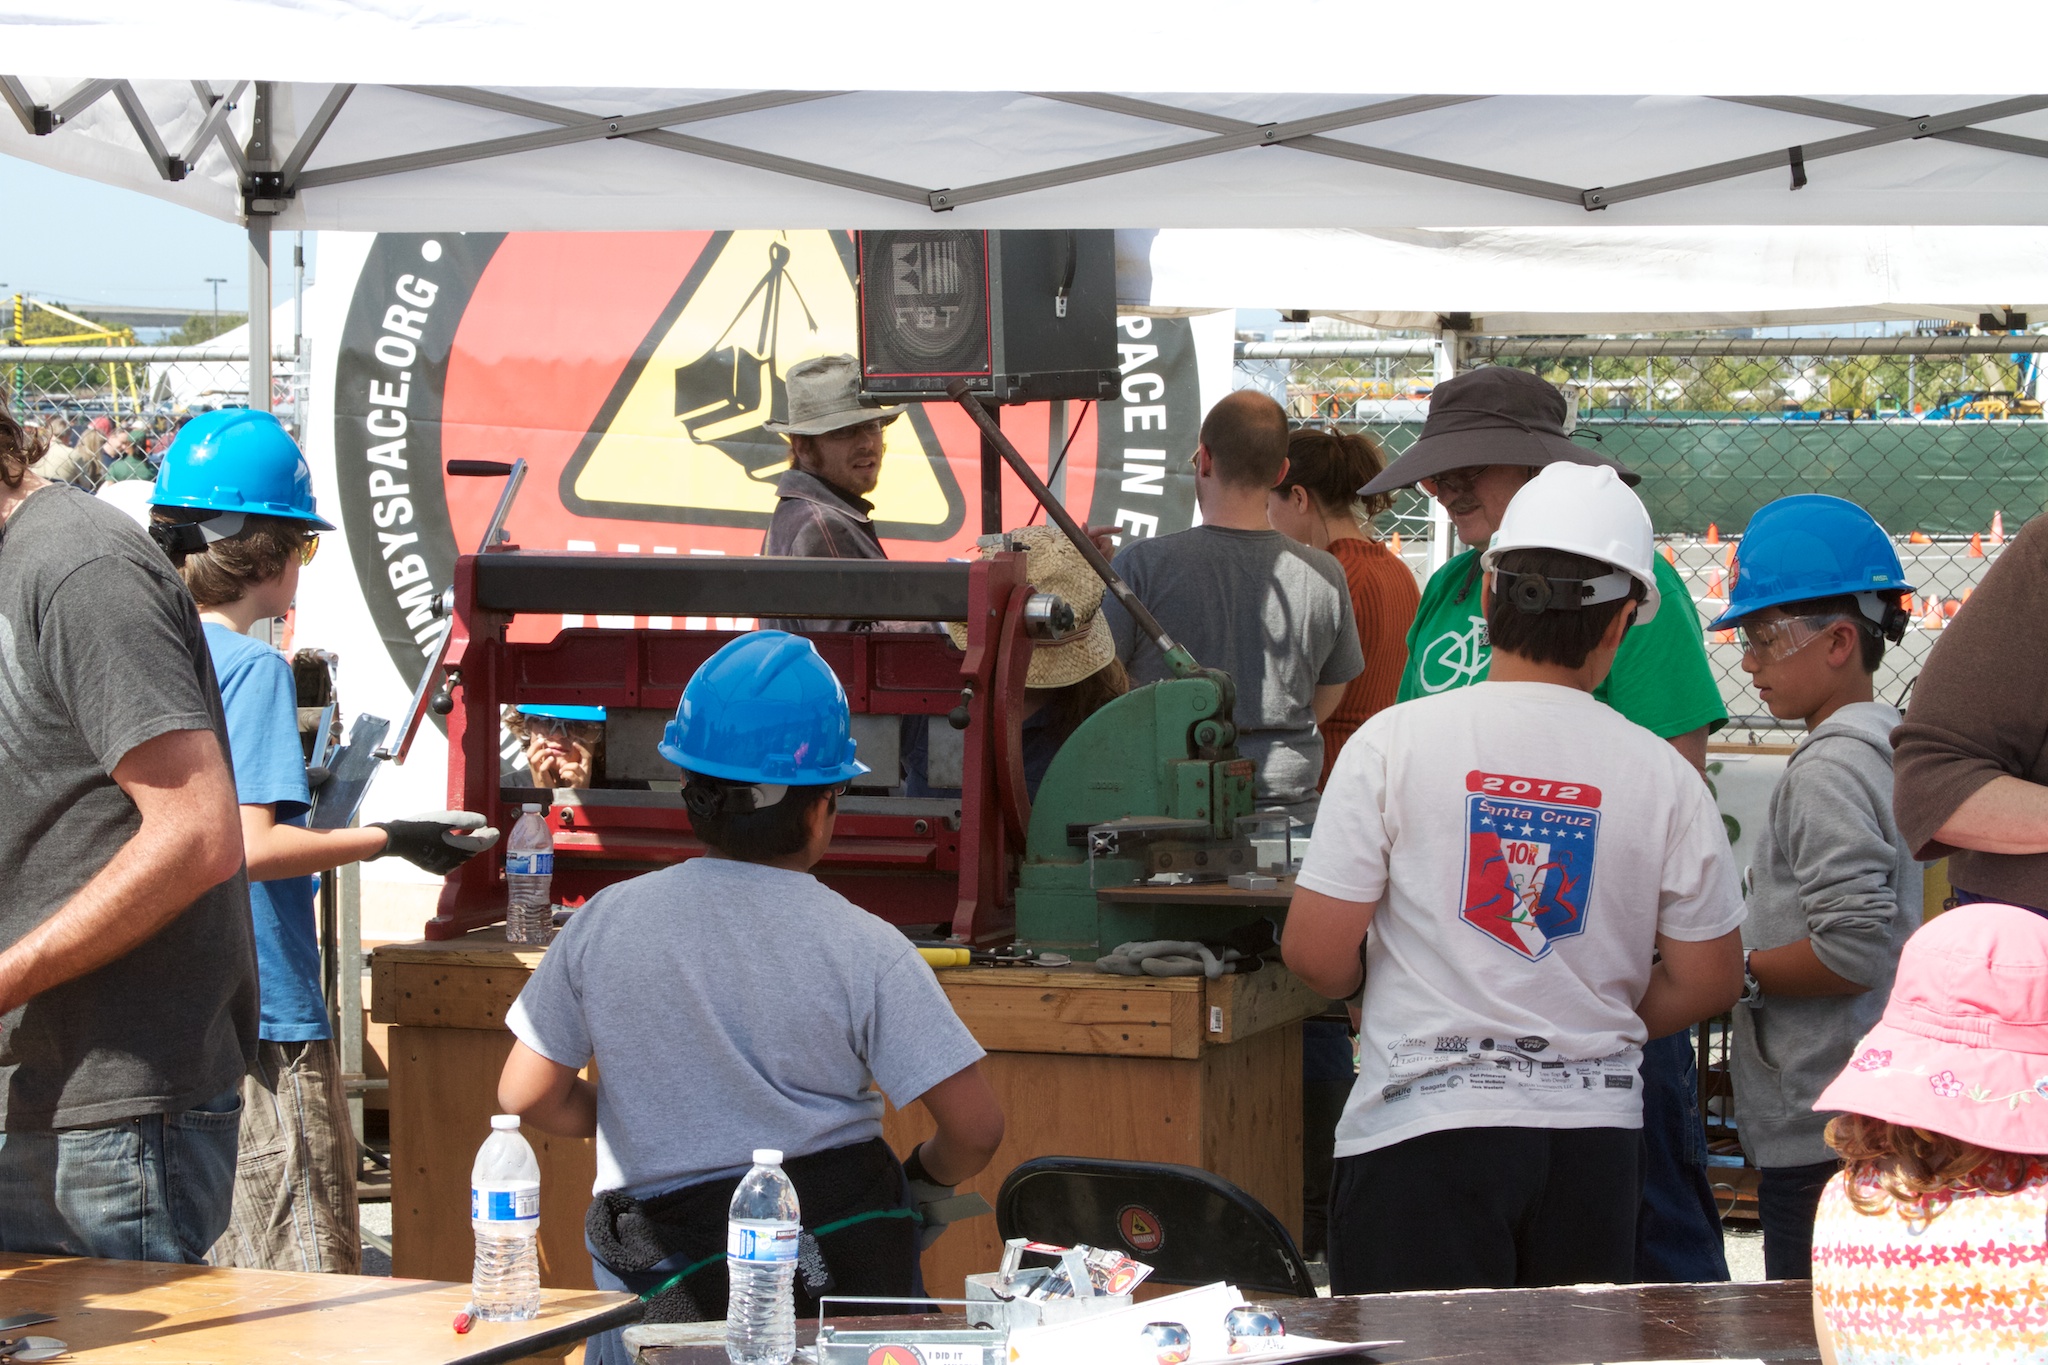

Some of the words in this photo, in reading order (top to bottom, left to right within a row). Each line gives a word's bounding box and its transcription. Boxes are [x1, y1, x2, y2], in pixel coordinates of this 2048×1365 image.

[894, 304, 960, 330] FBT
[978, 377, 989, 387] 12
[1116, 315, 1167, 432] PACE
[367, 273, 440, 657] IMBYSPACE.ORG
[1120, 447, 1166, 496] IN
[1111, 508, 1159, 547] E
[1482, 777, 1582, 800] 2012
[1479, 800, 1533, 820] Santa
[1540, 810, 1593, 827] Cruz
[1384, 1086, 1412, 1101] MetLife
[1420, 1083, 1447, 1092] Seagate
[1133, 1234, 1156, 1244] NIMBY
[935, 1351, 950, 1360] DID
[953, 1352, 963, 1360] IT
